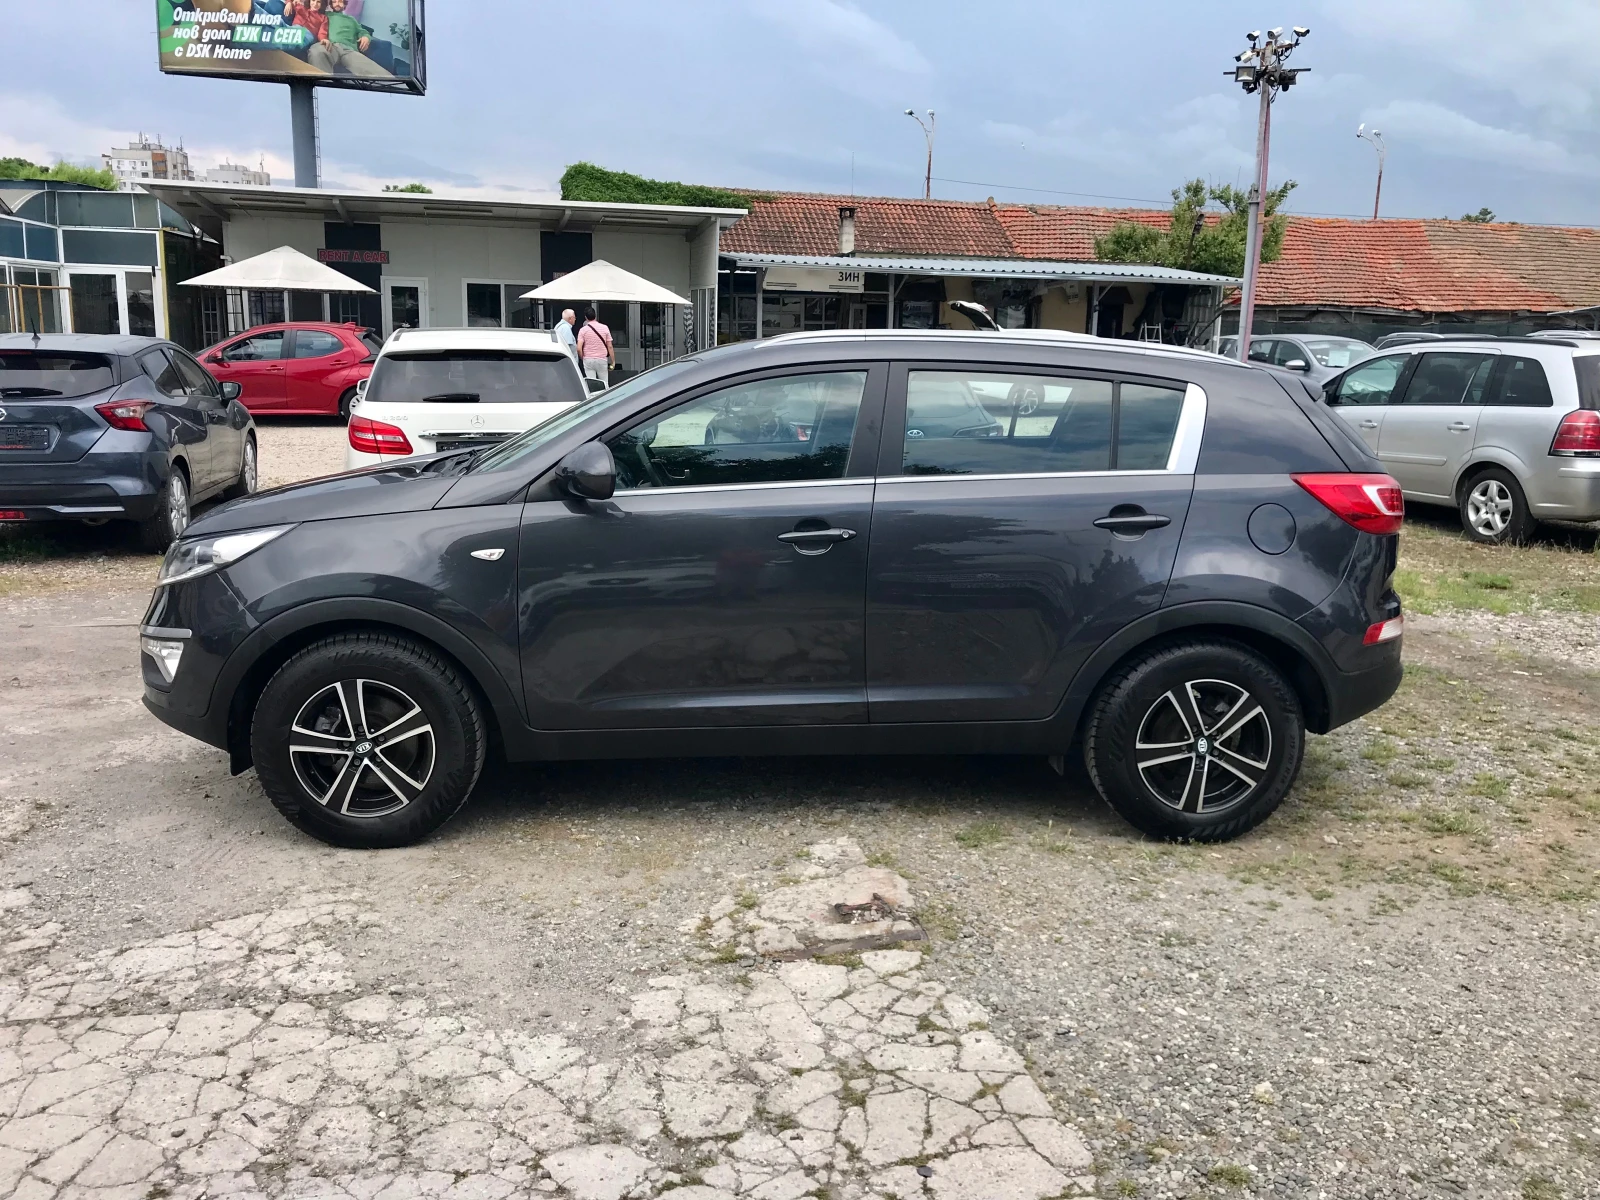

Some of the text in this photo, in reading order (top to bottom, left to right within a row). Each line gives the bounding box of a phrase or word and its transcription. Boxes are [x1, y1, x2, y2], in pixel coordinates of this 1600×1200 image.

[173, 6, 282, 26] Откривам моя
[172, 24, 303, 44] нов дом ТУК и СЕГА
[185, 43, 213, 58] DSK
[212, 44, 252, 60] Home
[318, 249, 388, 263] RENT A CAR
[837, 271, 860, 283] ЗИН
[357, 743, 371, 752] KIA
